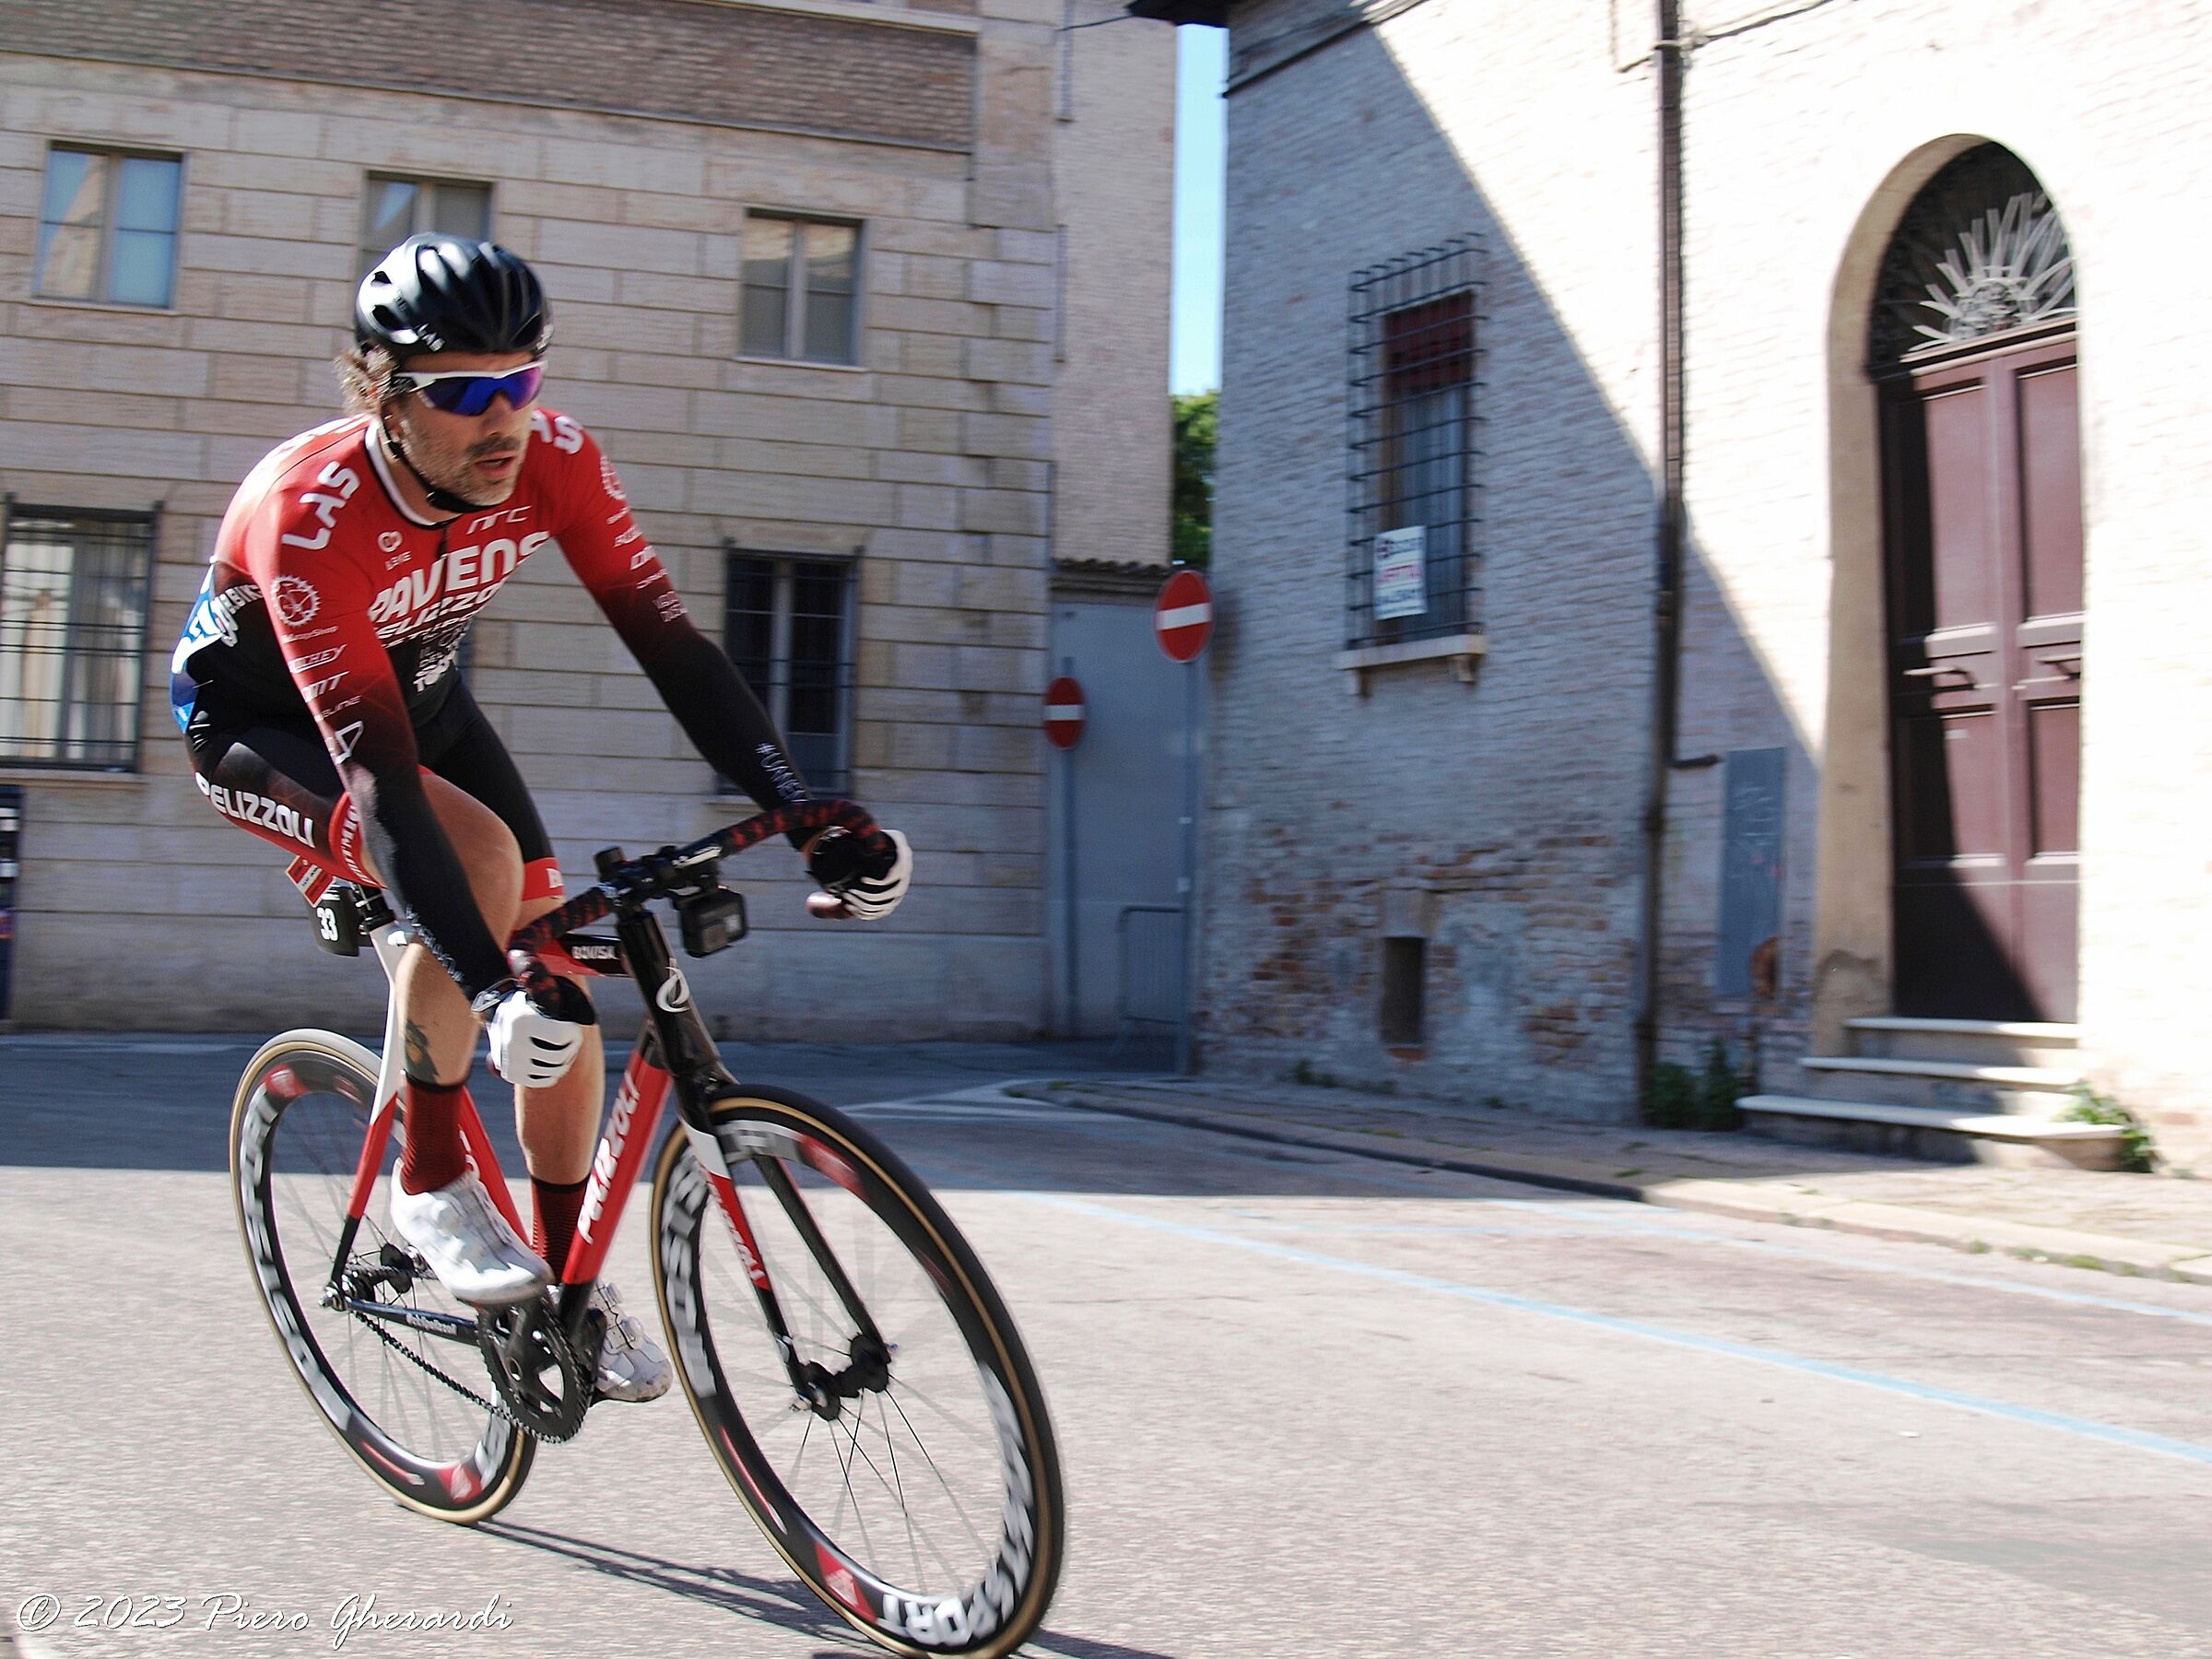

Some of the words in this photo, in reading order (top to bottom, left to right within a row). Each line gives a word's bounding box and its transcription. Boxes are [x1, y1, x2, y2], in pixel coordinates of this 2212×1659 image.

[530, 409, 584, 454] AS
[281, 460, 360, 550] LAS
[195, 771, 315, 849] PELIZZOLI
